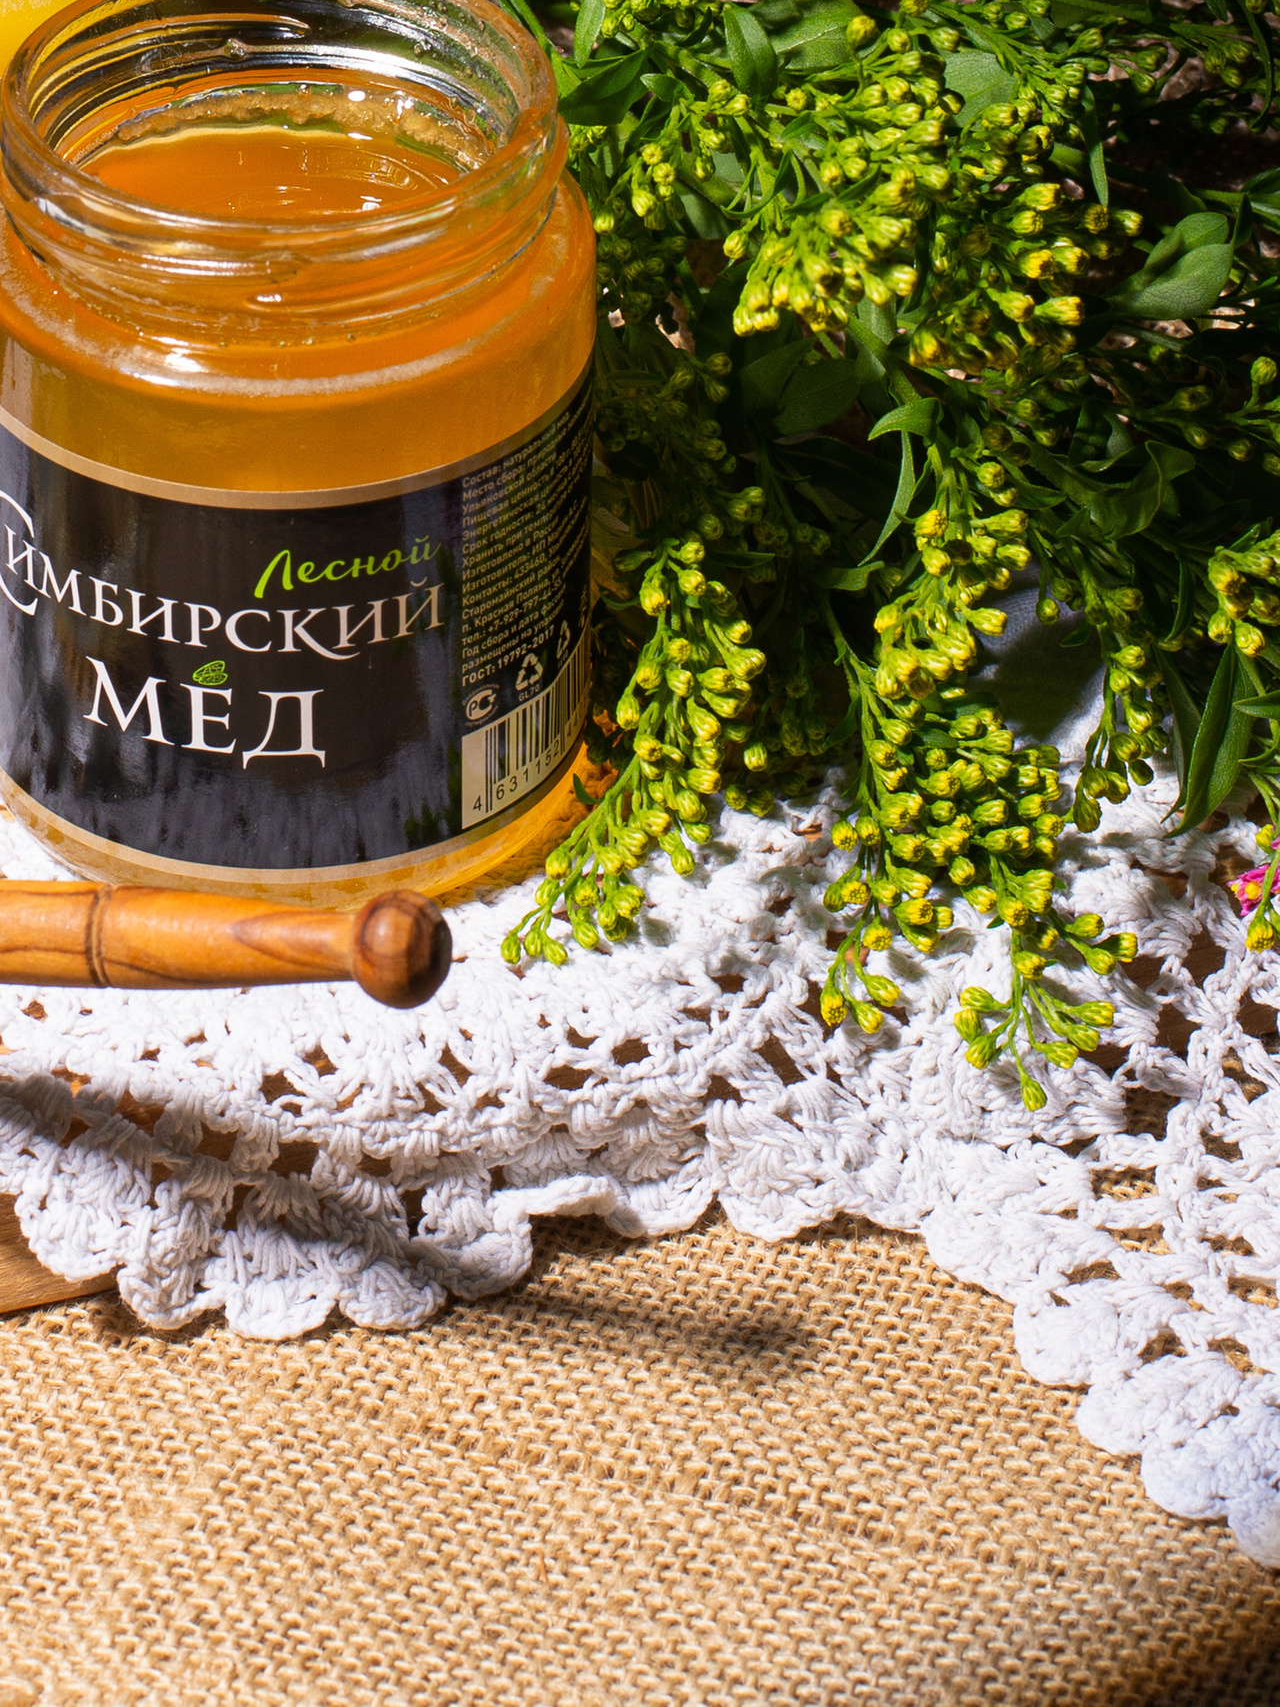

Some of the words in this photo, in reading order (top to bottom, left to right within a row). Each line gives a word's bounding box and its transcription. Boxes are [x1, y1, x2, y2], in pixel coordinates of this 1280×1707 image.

[462, 464, 500, 488] Состав:
[462, 480, 494, 502] Место
[496, 462, 524, 487] сбора:
[462, 473, 524, 515] Ульяновской
[462, 498, 508, 528] Пищевая
[462, 534, 488, 555] Срок
[490, 510, 533, 542] годности:
[253, 534, 442, 599] Лесной
[462, 541, 504, 568] Хранить
[505, 529, 522, 546] при
[462, 541, 523, 580] Изготовлено
[462, 550, 529, 593] Изготовитель:
[462, 576, 512, 607] Контакты:
[462, 570, 535, 620] Старомайнский
[474, 599, 514, 628] Красная
[462, 643, 479, 659] Год
[481, 627, 508, 650] сбора
[518, 610, 538, 630] дата
[462, 635, 518, 674] размещены
[462, 663, 495, 687] ГОСТ:
[497, 623, 554, 670] 19792-2017
[473, 795, 483, 811] 4
